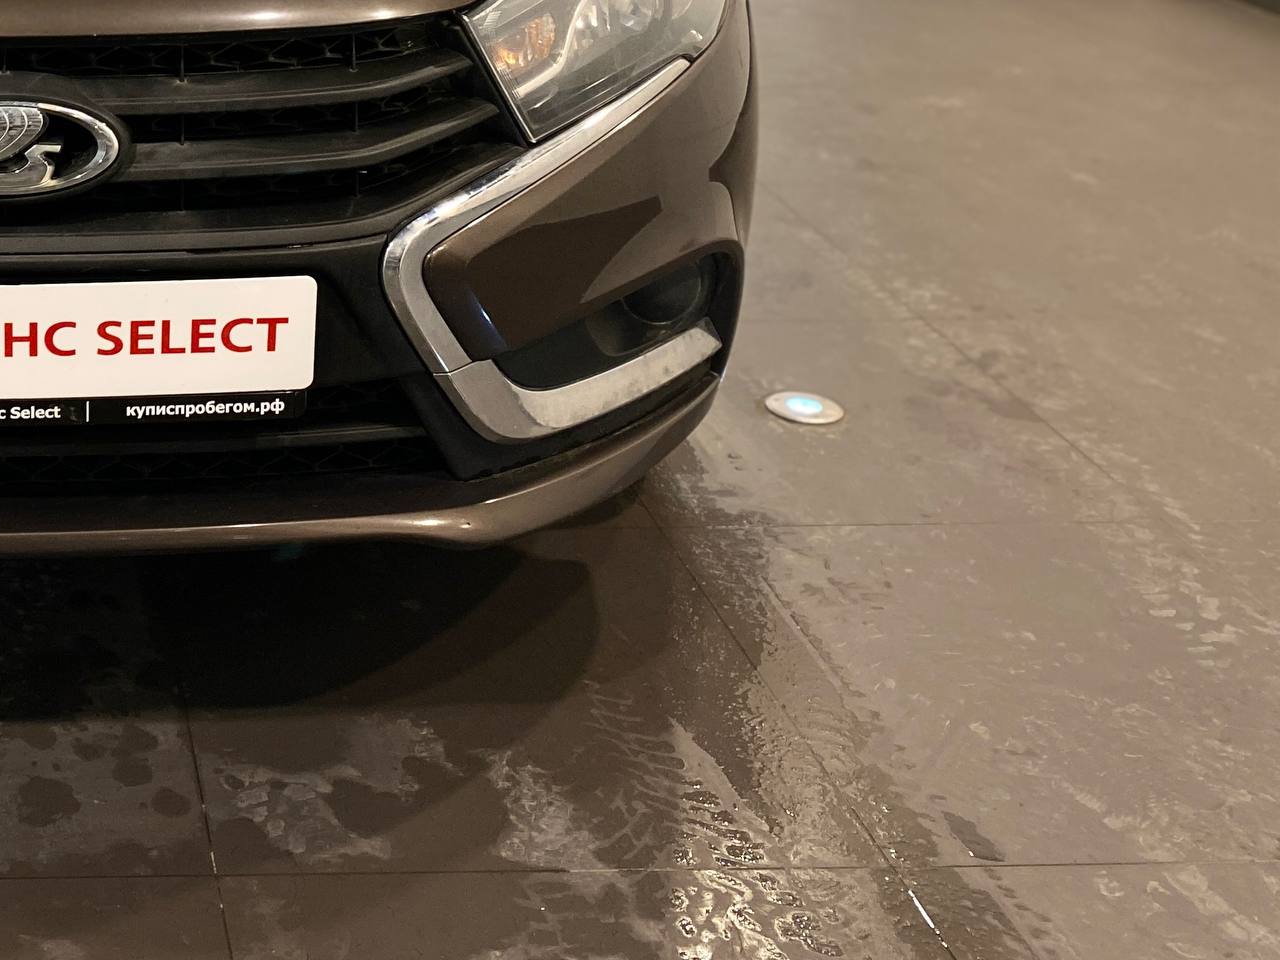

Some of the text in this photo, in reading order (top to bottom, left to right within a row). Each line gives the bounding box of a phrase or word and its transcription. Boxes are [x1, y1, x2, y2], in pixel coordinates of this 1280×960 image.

[96, 317, 289, 356] SELECT
[9, 405, 62, 419] Select
[125, 398, 285, 419] куписпробегом.рф
